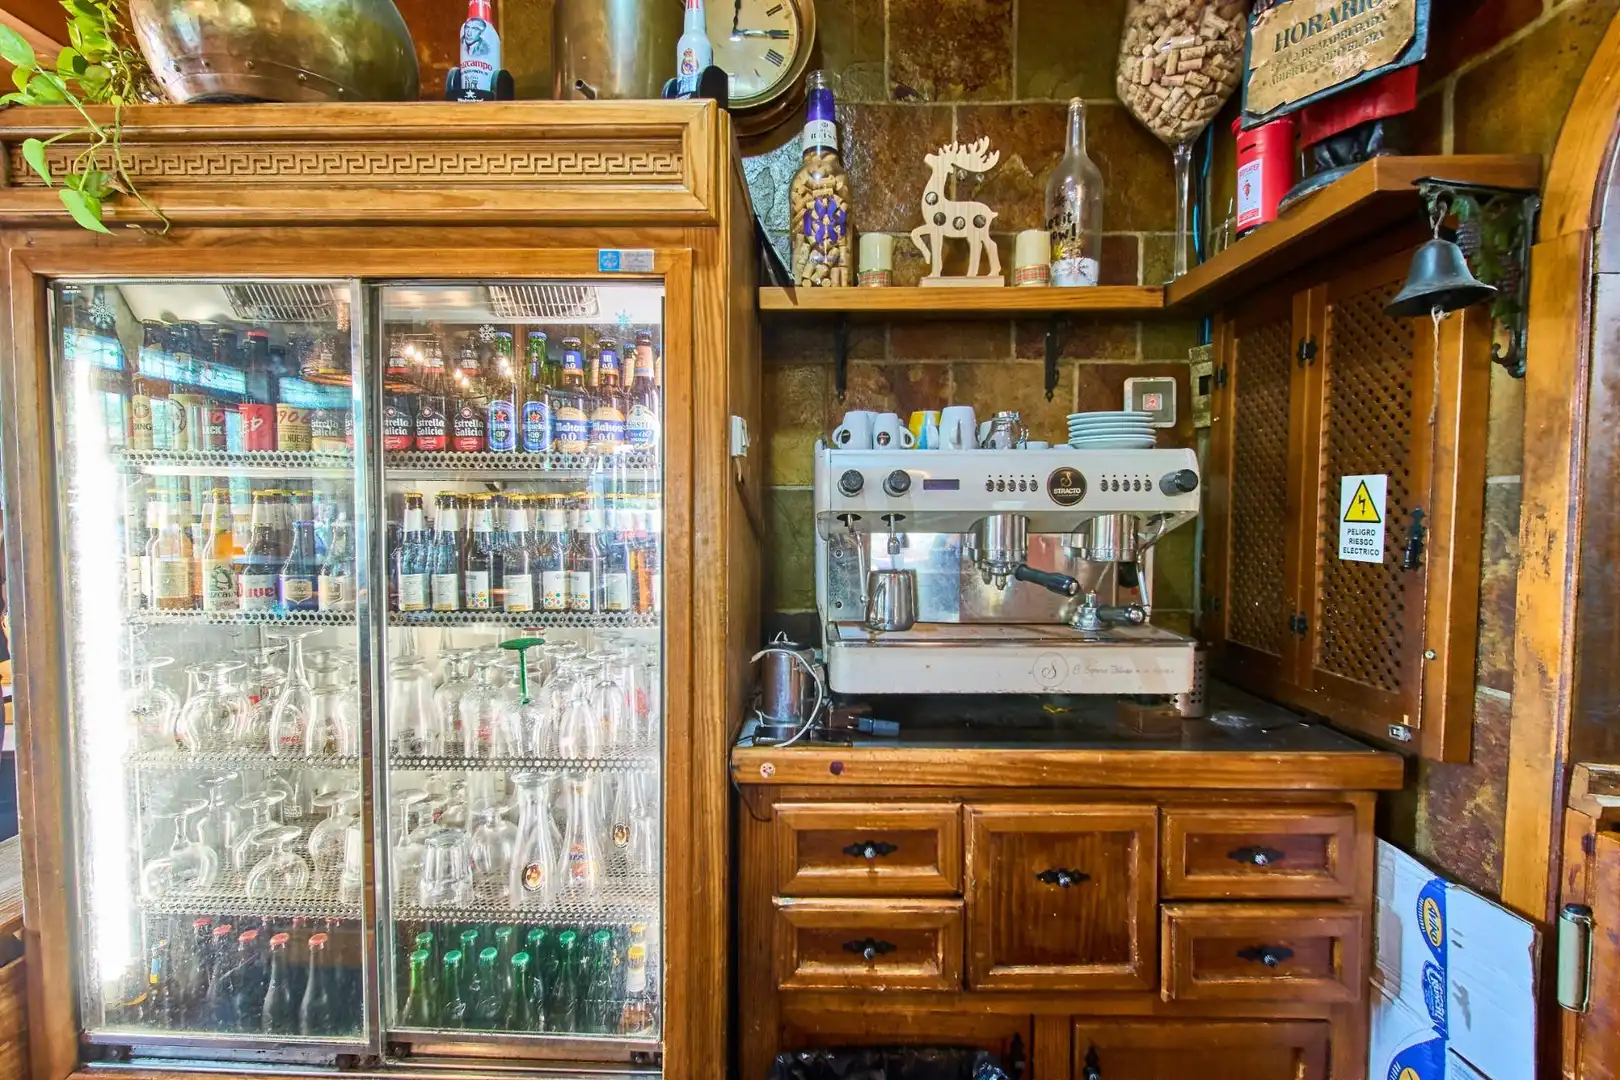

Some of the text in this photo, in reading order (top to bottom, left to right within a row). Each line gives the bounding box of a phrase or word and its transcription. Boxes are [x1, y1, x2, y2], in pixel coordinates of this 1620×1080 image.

[385, 427, 408, 436] alicia
[1053, 487, 1082, 495] STRACTO
[1347, 528, 1376, 537] PELIGRO
[1348, 538, 1374, 546] RIESGO
[1342, 547, 1380, 556] ELECTRICO
